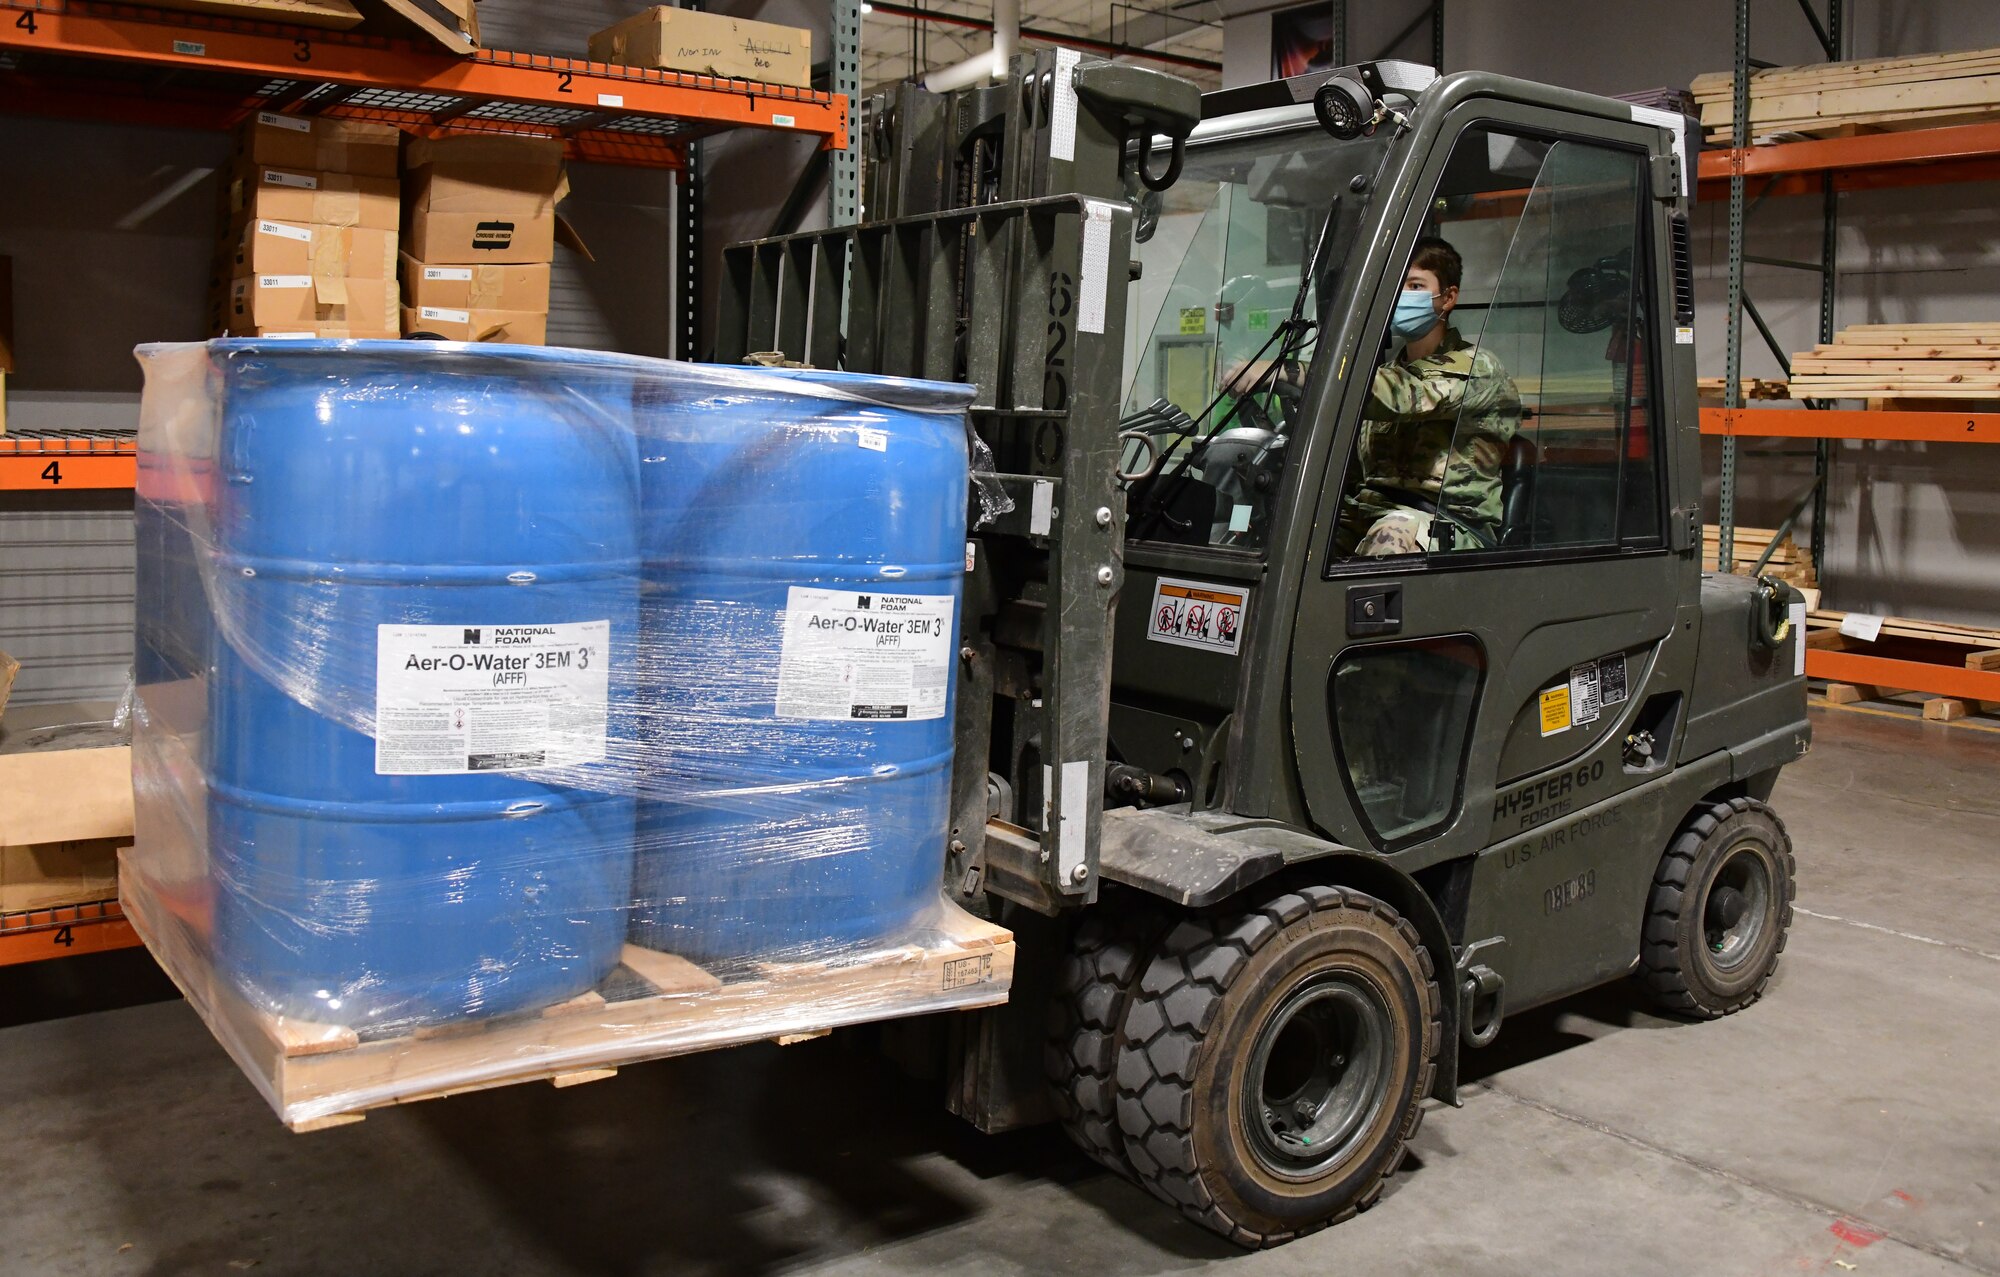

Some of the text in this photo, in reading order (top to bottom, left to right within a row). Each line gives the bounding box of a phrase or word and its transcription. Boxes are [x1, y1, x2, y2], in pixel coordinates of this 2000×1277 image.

[16, 10, 38, 34] 4
[294, 39, 311, 62] 3
[558, 72, 573, 93] 2
[746, 92, 755, 112] 1
[261, 114, 277, 124] 33011
[267, 173, 282, 182] 33011
[262, 223, 278, 233] 33011
[427, 270, 441, 278] 33011
[263, 278, 278, 286] 33011
[424, 309, 438, 318] 33011
[1967, 420, 1975, 432] 2
[41, 460, 62, 485] 4
[881, 596, 923, 605] NATIONAL
[495, 627, 556, 636] NATIONAL
[495, 636, 532, 645] FOAM
[875, 634, 901, 648] (AFFF)
[492, 671, 527, 687] (AFFF)
[1493, 759, 1604, 822] HYSTER 60
[1520, 798, 1572, 829] FORTIS
[1504, 804, 1623, 870] U.S. AIR FORCE
